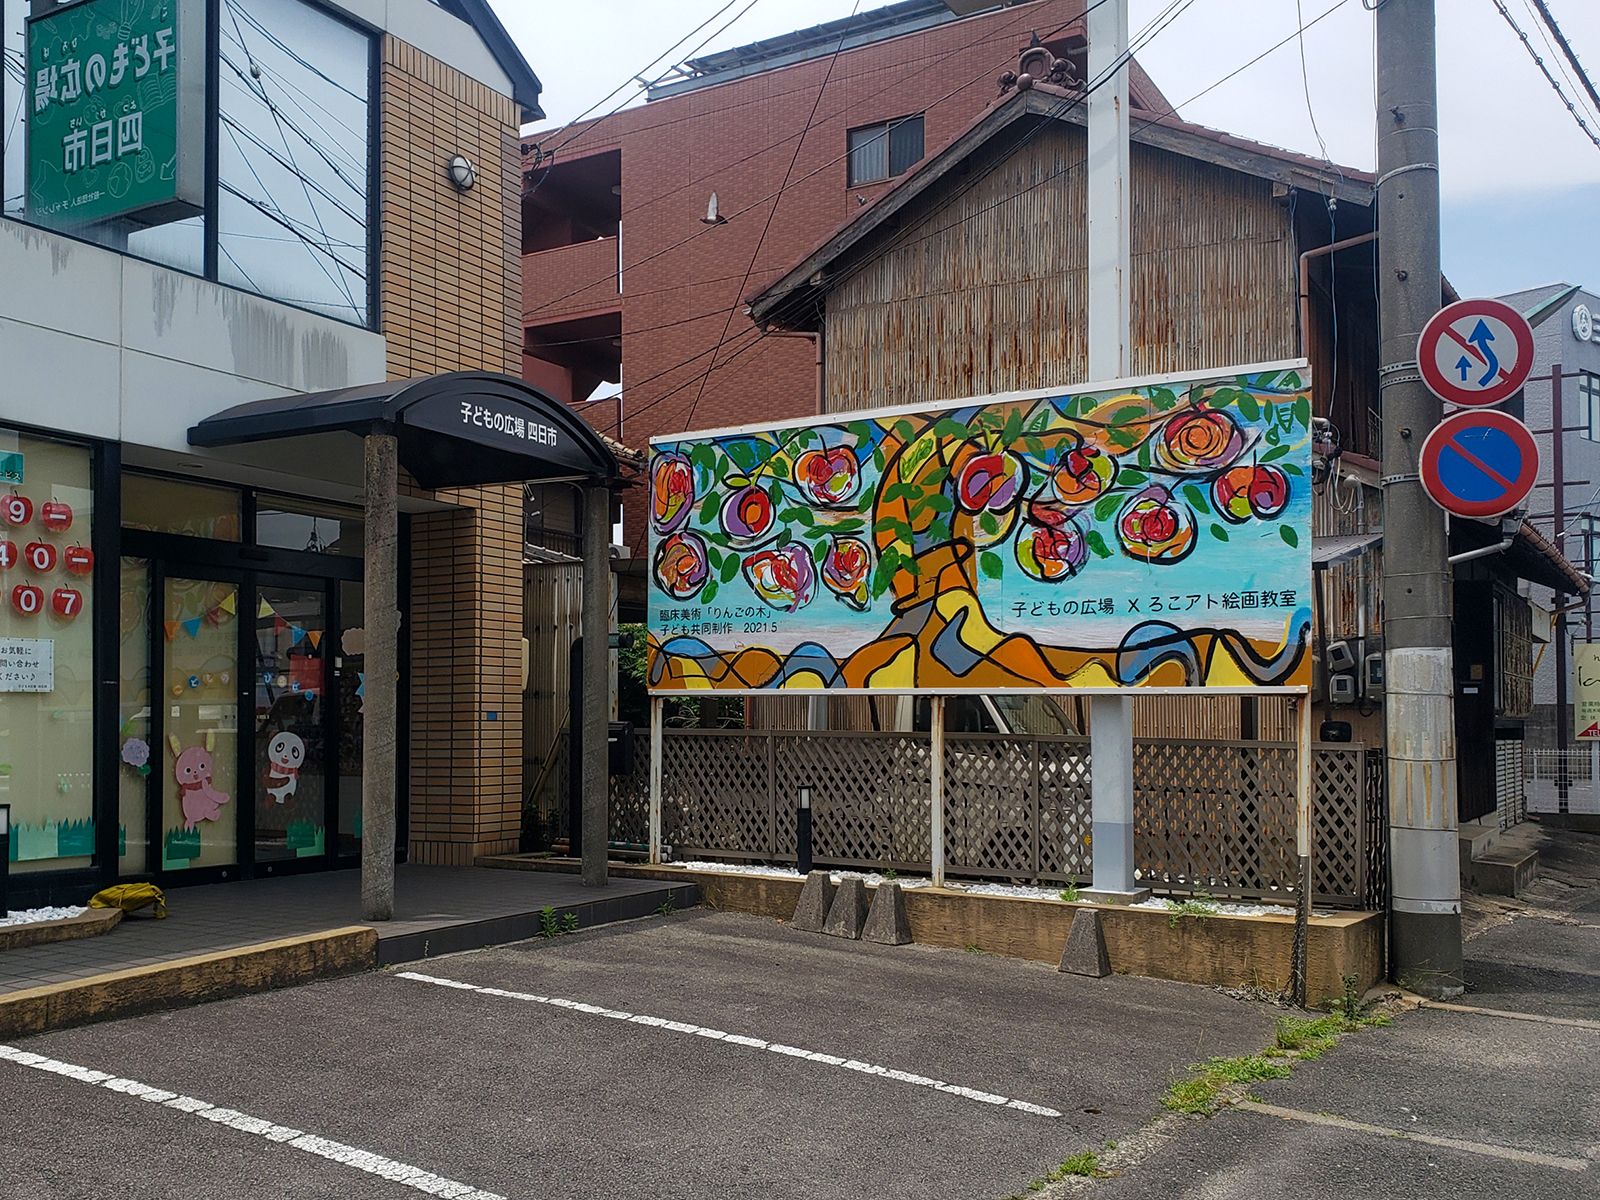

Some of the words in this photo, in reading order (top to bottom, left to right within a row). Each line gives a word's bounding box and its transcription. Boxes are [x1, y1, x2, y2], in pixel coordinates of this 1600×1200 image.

[460, 401, 525, 439] 子どもの広場
[527, 421, 557, 447] 四日市
[1011, 597, 1115, 618] 子どもの広場
[1149, 589, 1297, 612] ろこアト絵画教室
[660, 621, 734, 637] 子ども共同制作
[743, 621, 778, 634] 2021.5
